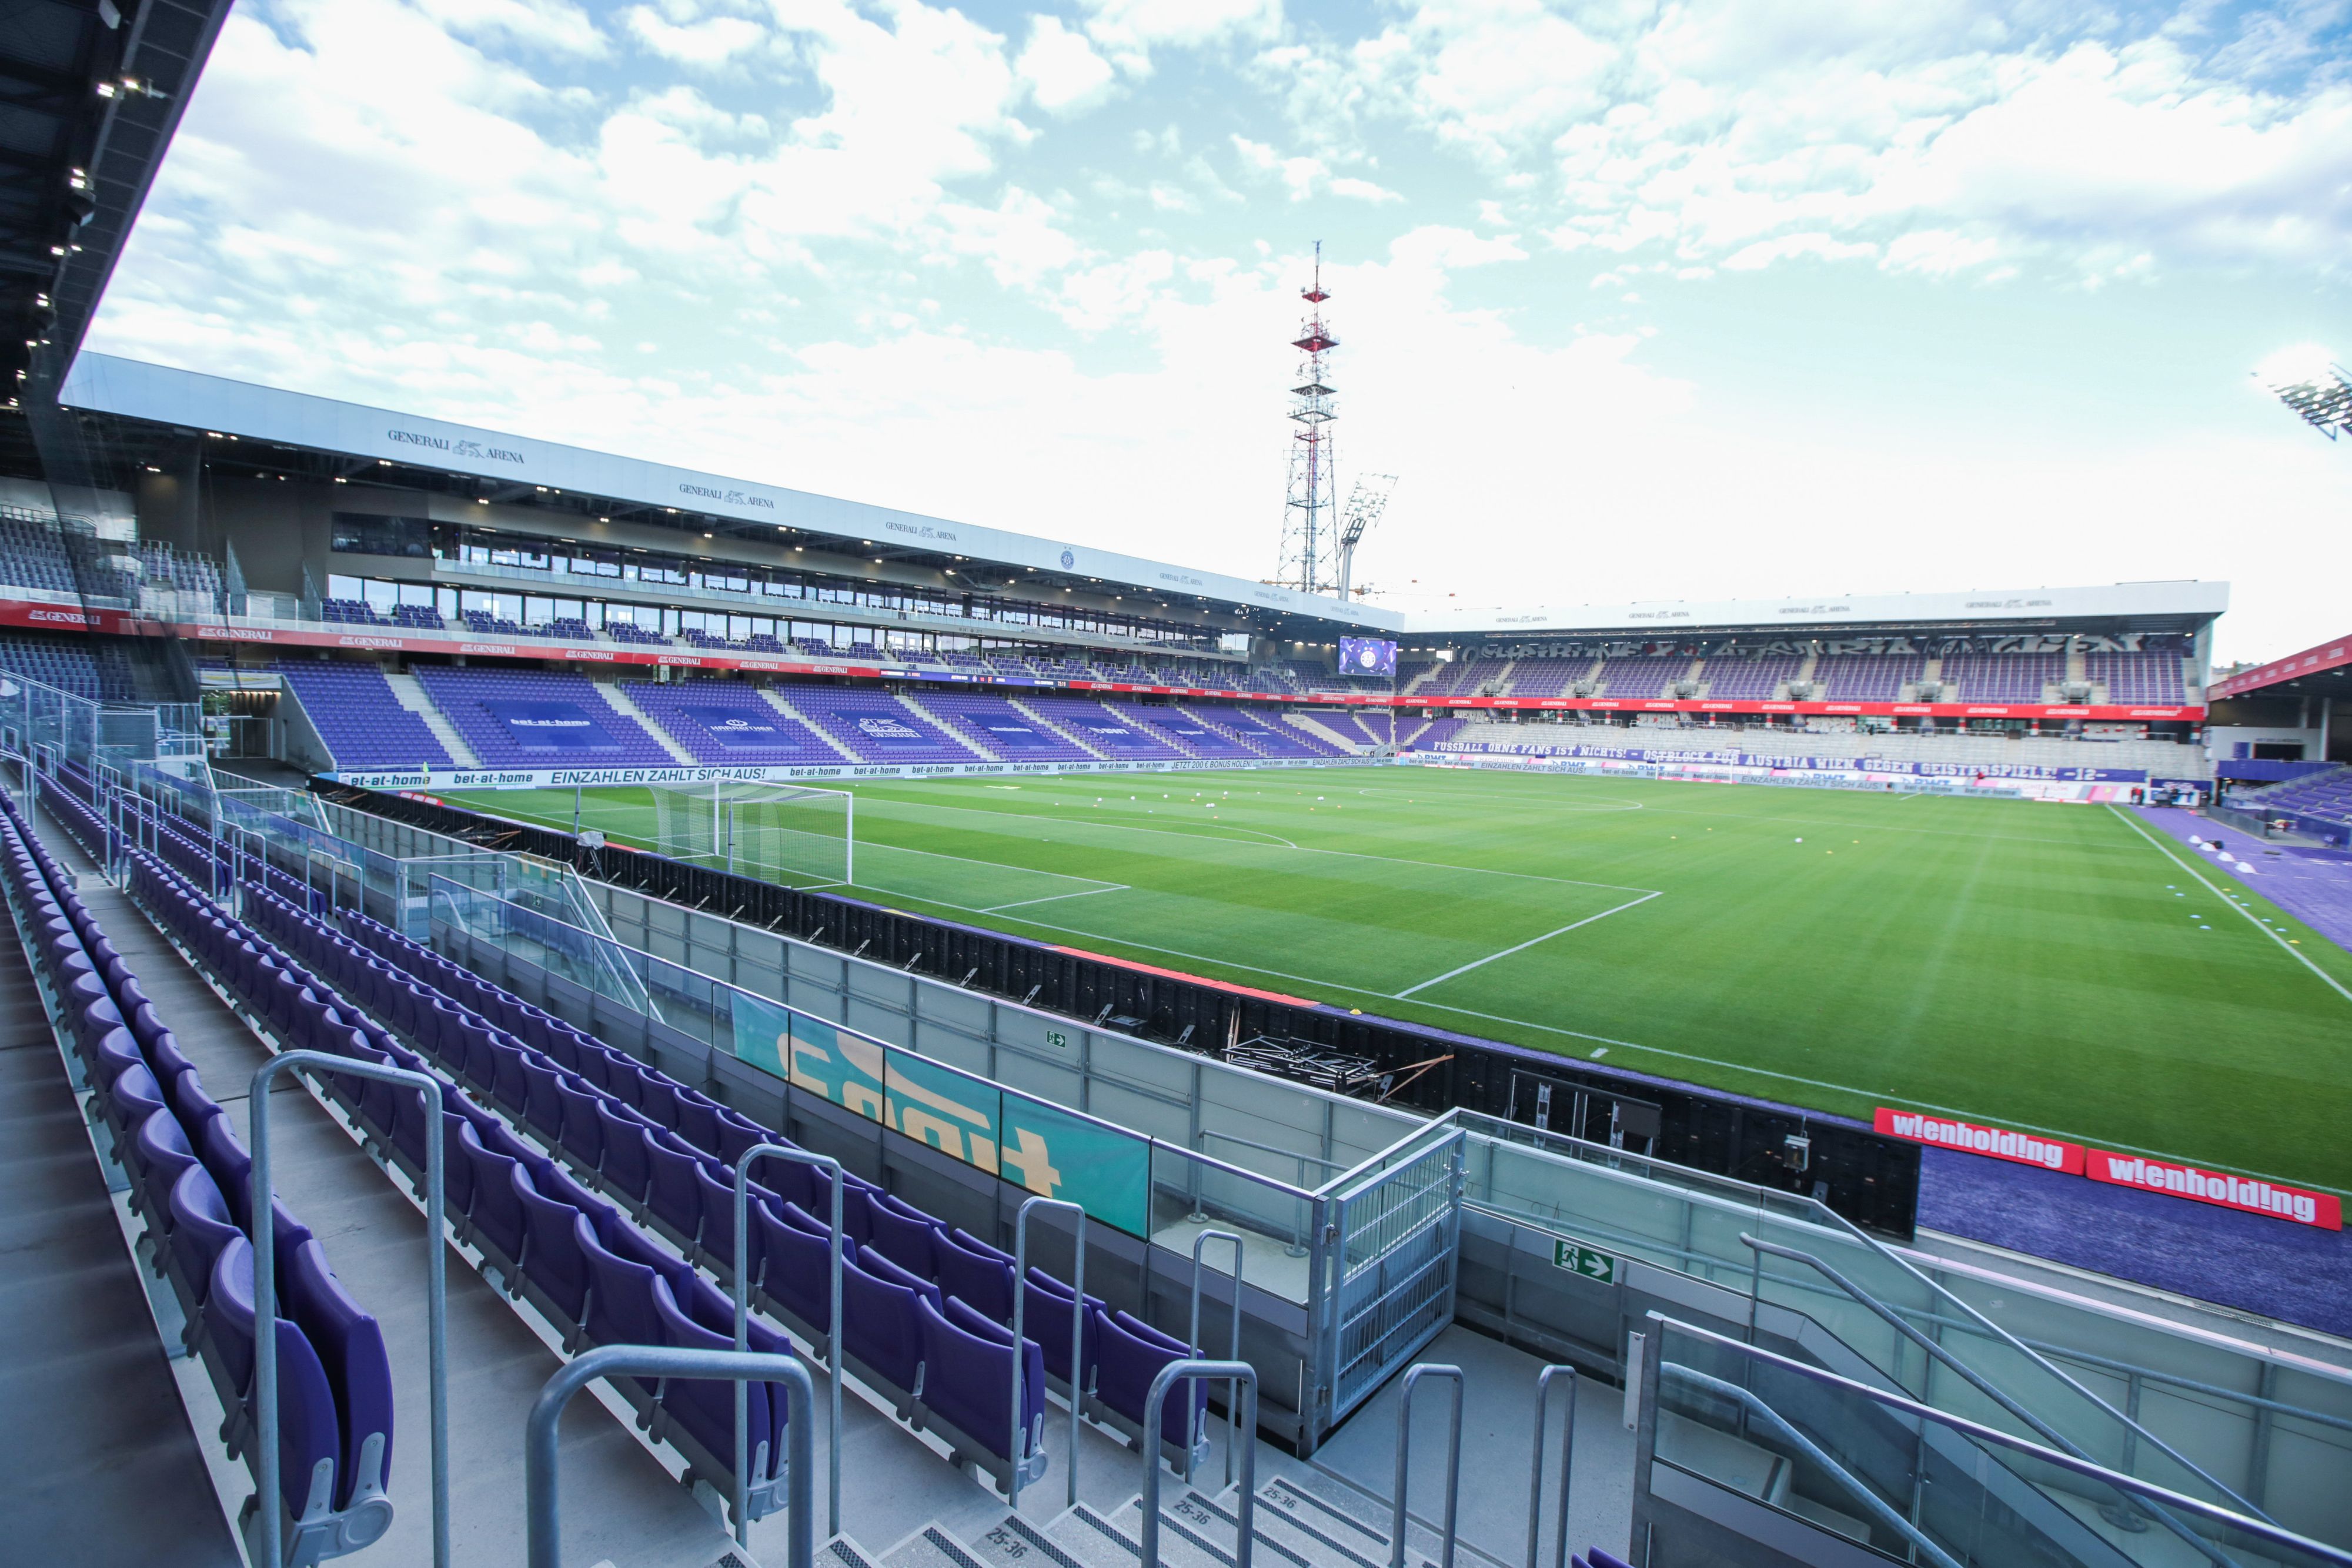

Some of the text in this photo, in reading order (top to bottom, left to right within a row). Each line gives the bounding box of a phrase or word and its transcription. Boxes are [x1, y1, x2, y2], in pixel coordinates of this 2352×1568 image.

[388, 429, 524, 464] GENERALI ARENA
[679, 483, 774, 509] GENERALI ARENA
[886, 521, 956, 541] GENERALI ARENA
[1160, 573, 1179, 581] GENERALI
[46, 611, 101, 625] GENERALI
[216, 628, 272, 640] GENERALI
[354, 637, 402, 647] GENERALI
[474, 644, 515, 654] GENERALI
[577, 650, 614, 660] GENERALI
[668, 657, 701, 665] GENERALI
[1171, 761, 1191, 769] JETZT
[1434, 741, 1483, 753] FUSSBALL
[1488, 744, 1517, 754] OHNE
[1521, 745, 1552, 755] FANS
[1555, 747, 1576, 755] IST
[1580, 747, 1626, 758] NICHTS!
[1643, 751, 1707, 762] OSTBLOCK
[1745, 755, 1809, 768] AUSTRIA
[1815, 758, 1858, 771] WIEN.
[1863, 759, 1913, 773] GEGEN
[1920, 763, 2057, 780] GEISTERSPIELE!
[551, 768, 766, 784] EINZAHLEN ZAHLT SICH AUS!
[790, 767, 841, 776] bet-at-home
[854, 767, 900, 775] bet-at-home
[351, 775, 431, 785] et-at-home
[455, 773, 533, 784] bet-at-home
[1741, 775, 1793, 785] EINZAHLEN
[1798, 778, 1827, 787] ZAHLT
[1830, 780, 1853, 788] SICH
[1262, 1486, 1297, 1510] 25-36
[1174, 1500, 1211, 1526] 25-36
[985, 1527, 1027, 1559] 25-36
